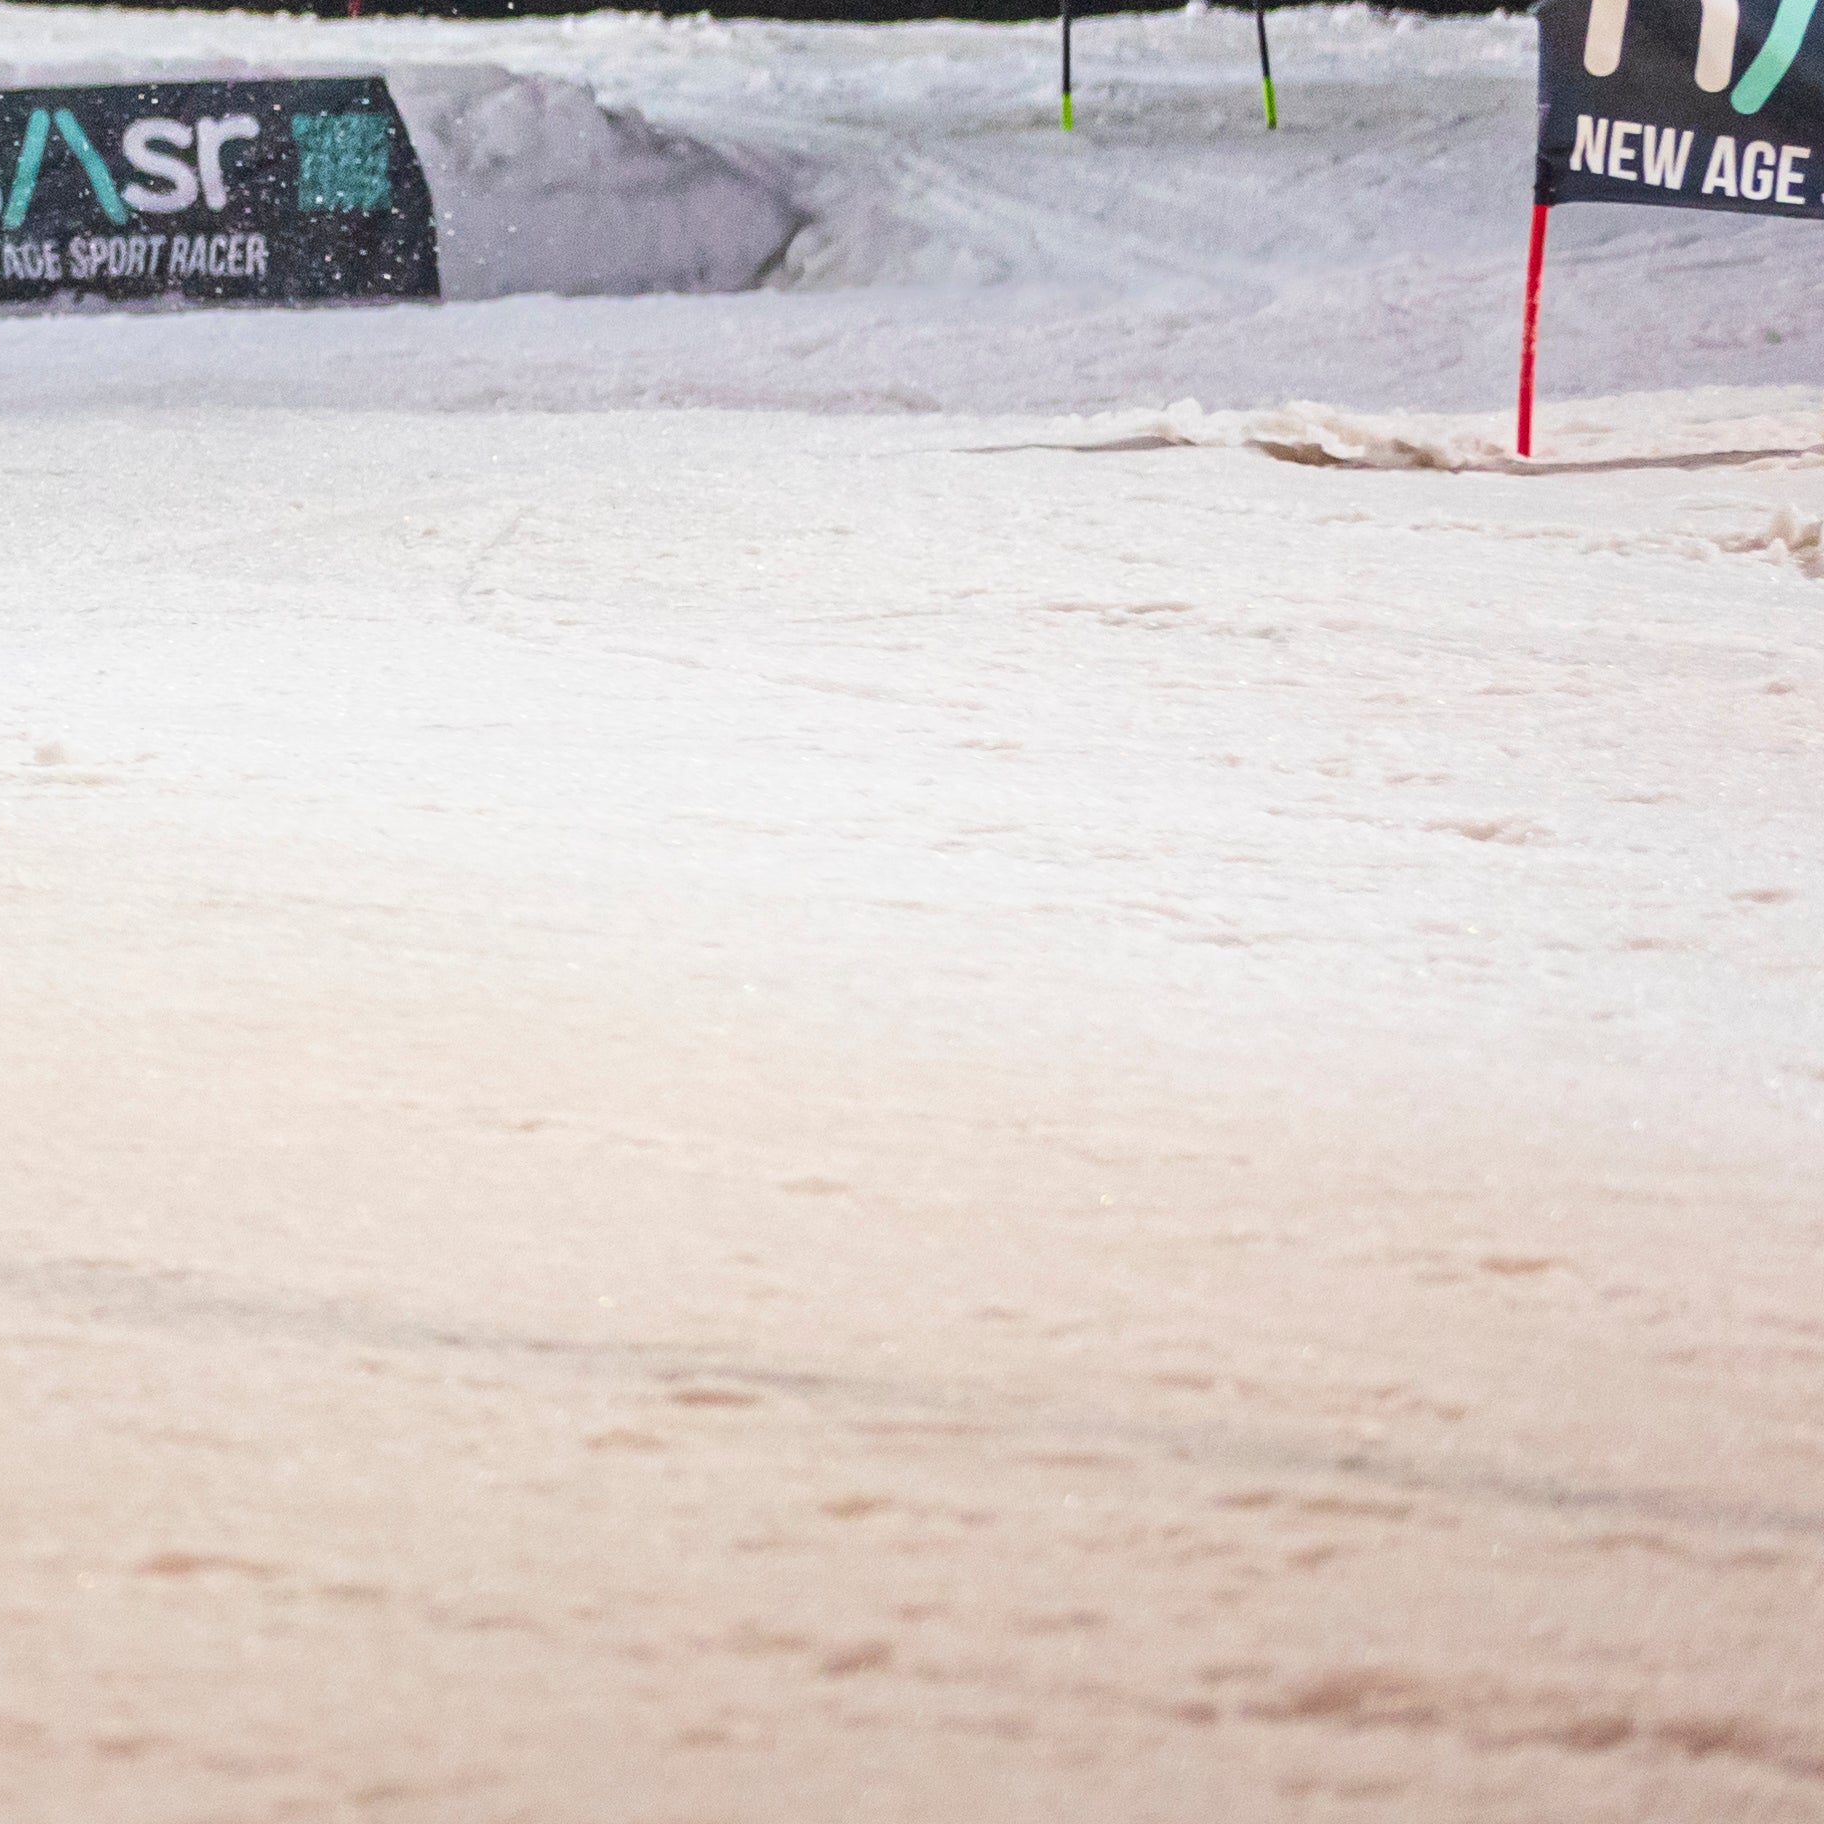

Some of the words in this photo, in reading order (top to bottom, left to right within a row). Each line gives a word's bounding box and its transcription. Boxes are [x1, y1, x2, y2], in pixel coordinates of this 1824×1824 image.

[1569, 113, 1695, 191] NEW
[1701, 135, 1812, 206] AGE
[69, 234, 168, 279] SPORT
[169, 231, 270, 279] RACER
